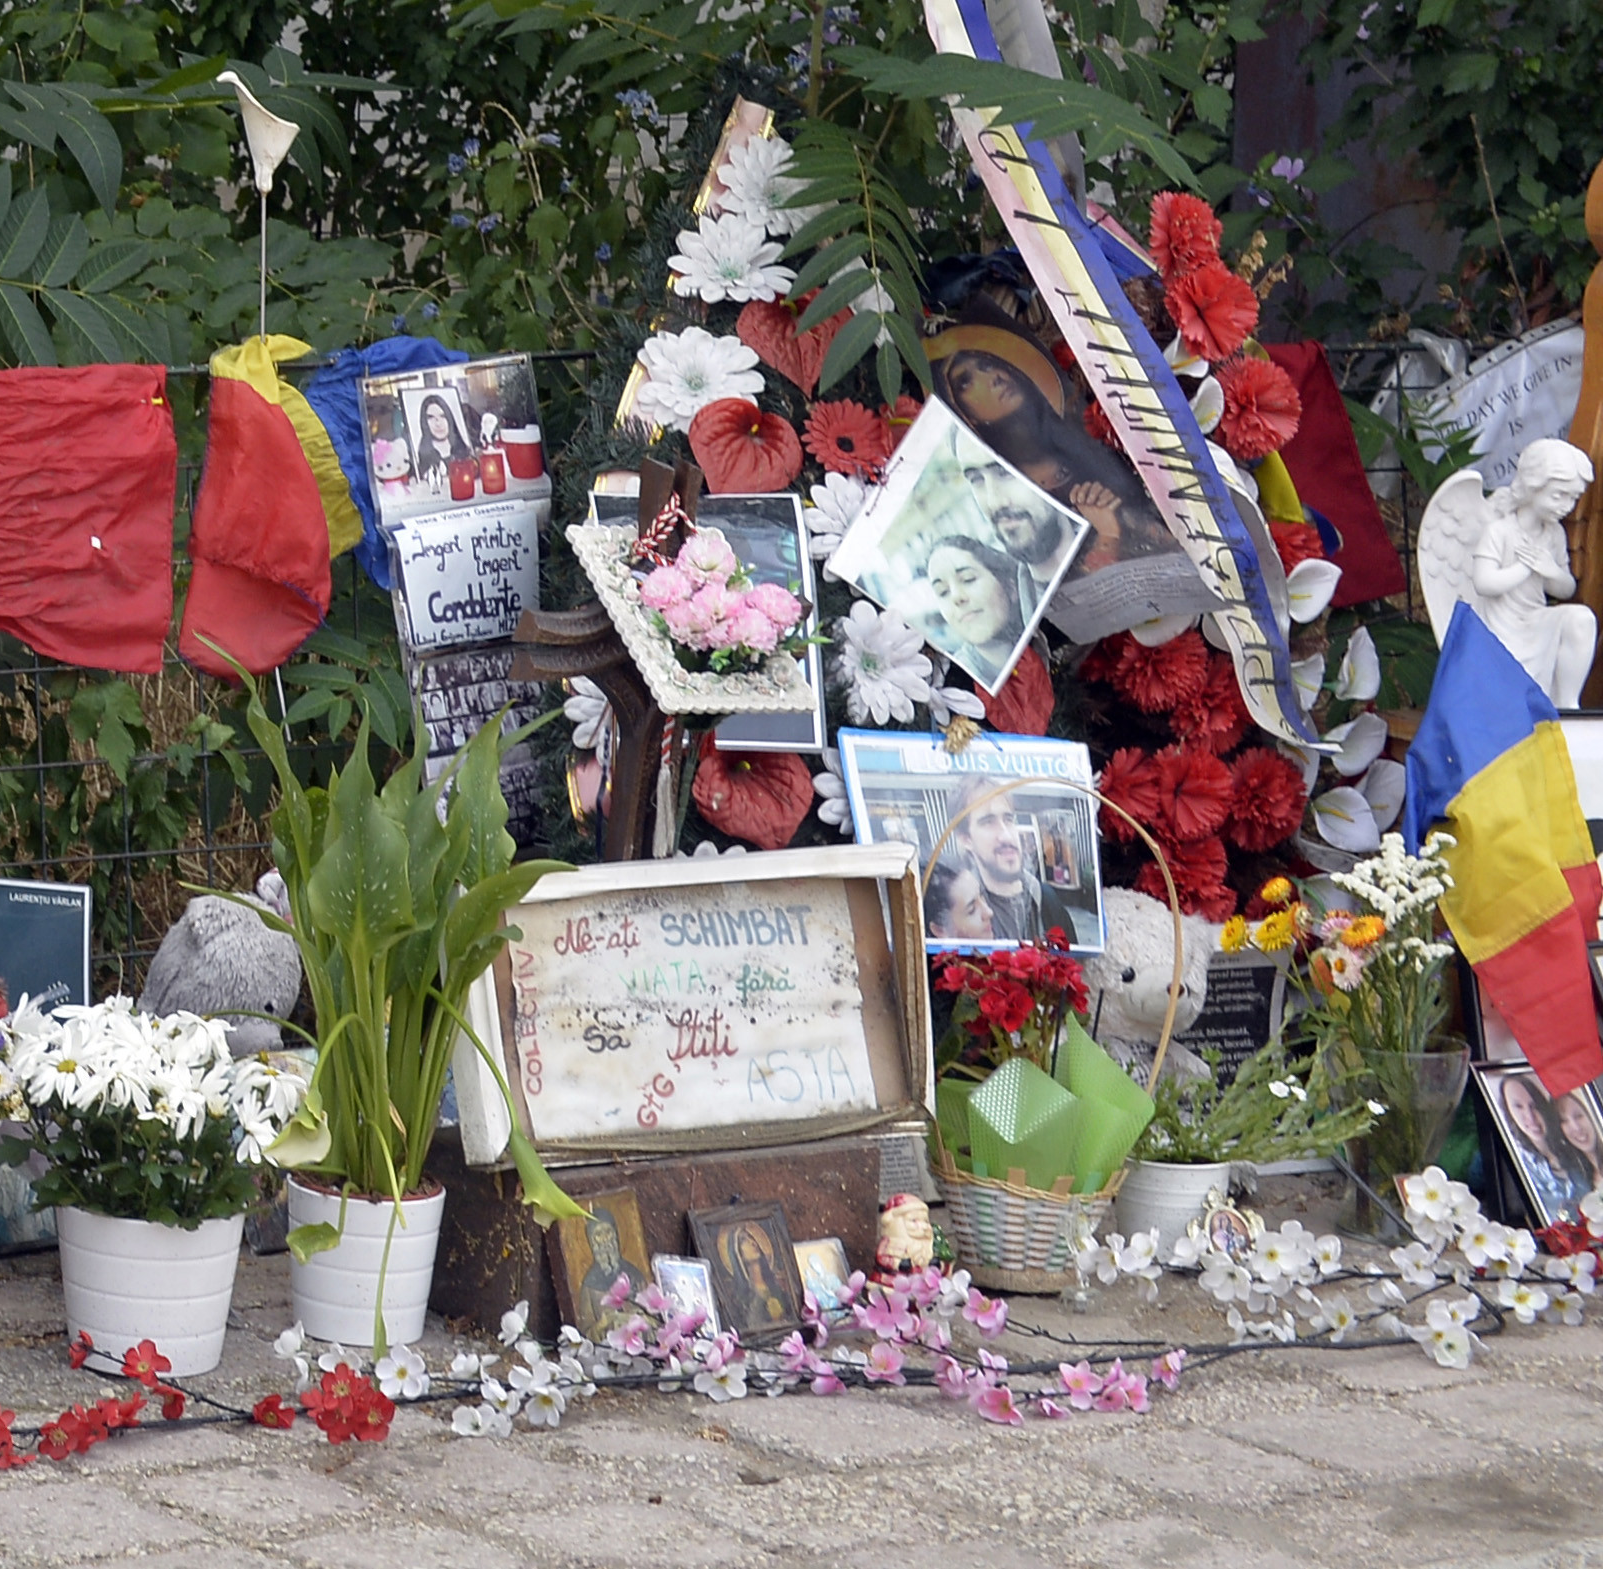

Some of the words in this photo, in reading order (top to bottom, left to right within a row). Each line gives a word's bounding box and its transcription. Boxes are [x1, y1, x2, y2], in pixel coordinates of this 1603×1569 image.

[1466, 397, 1496, 430] DAY
[1498, 385, 1522, 408] WE
[1523, 365, 1552, 393] GIVE
[1554, 355, 1574, 373] IN
[995, 753, 1090, 779] VUITTON
[8, 892, 51, 907] LAURENȚIU
[658, 904, 813, 948] SCHIMBAT
[512, 947, 544, 1096] COLECTIV
[746, 1044, 856, 1104] ASTA
